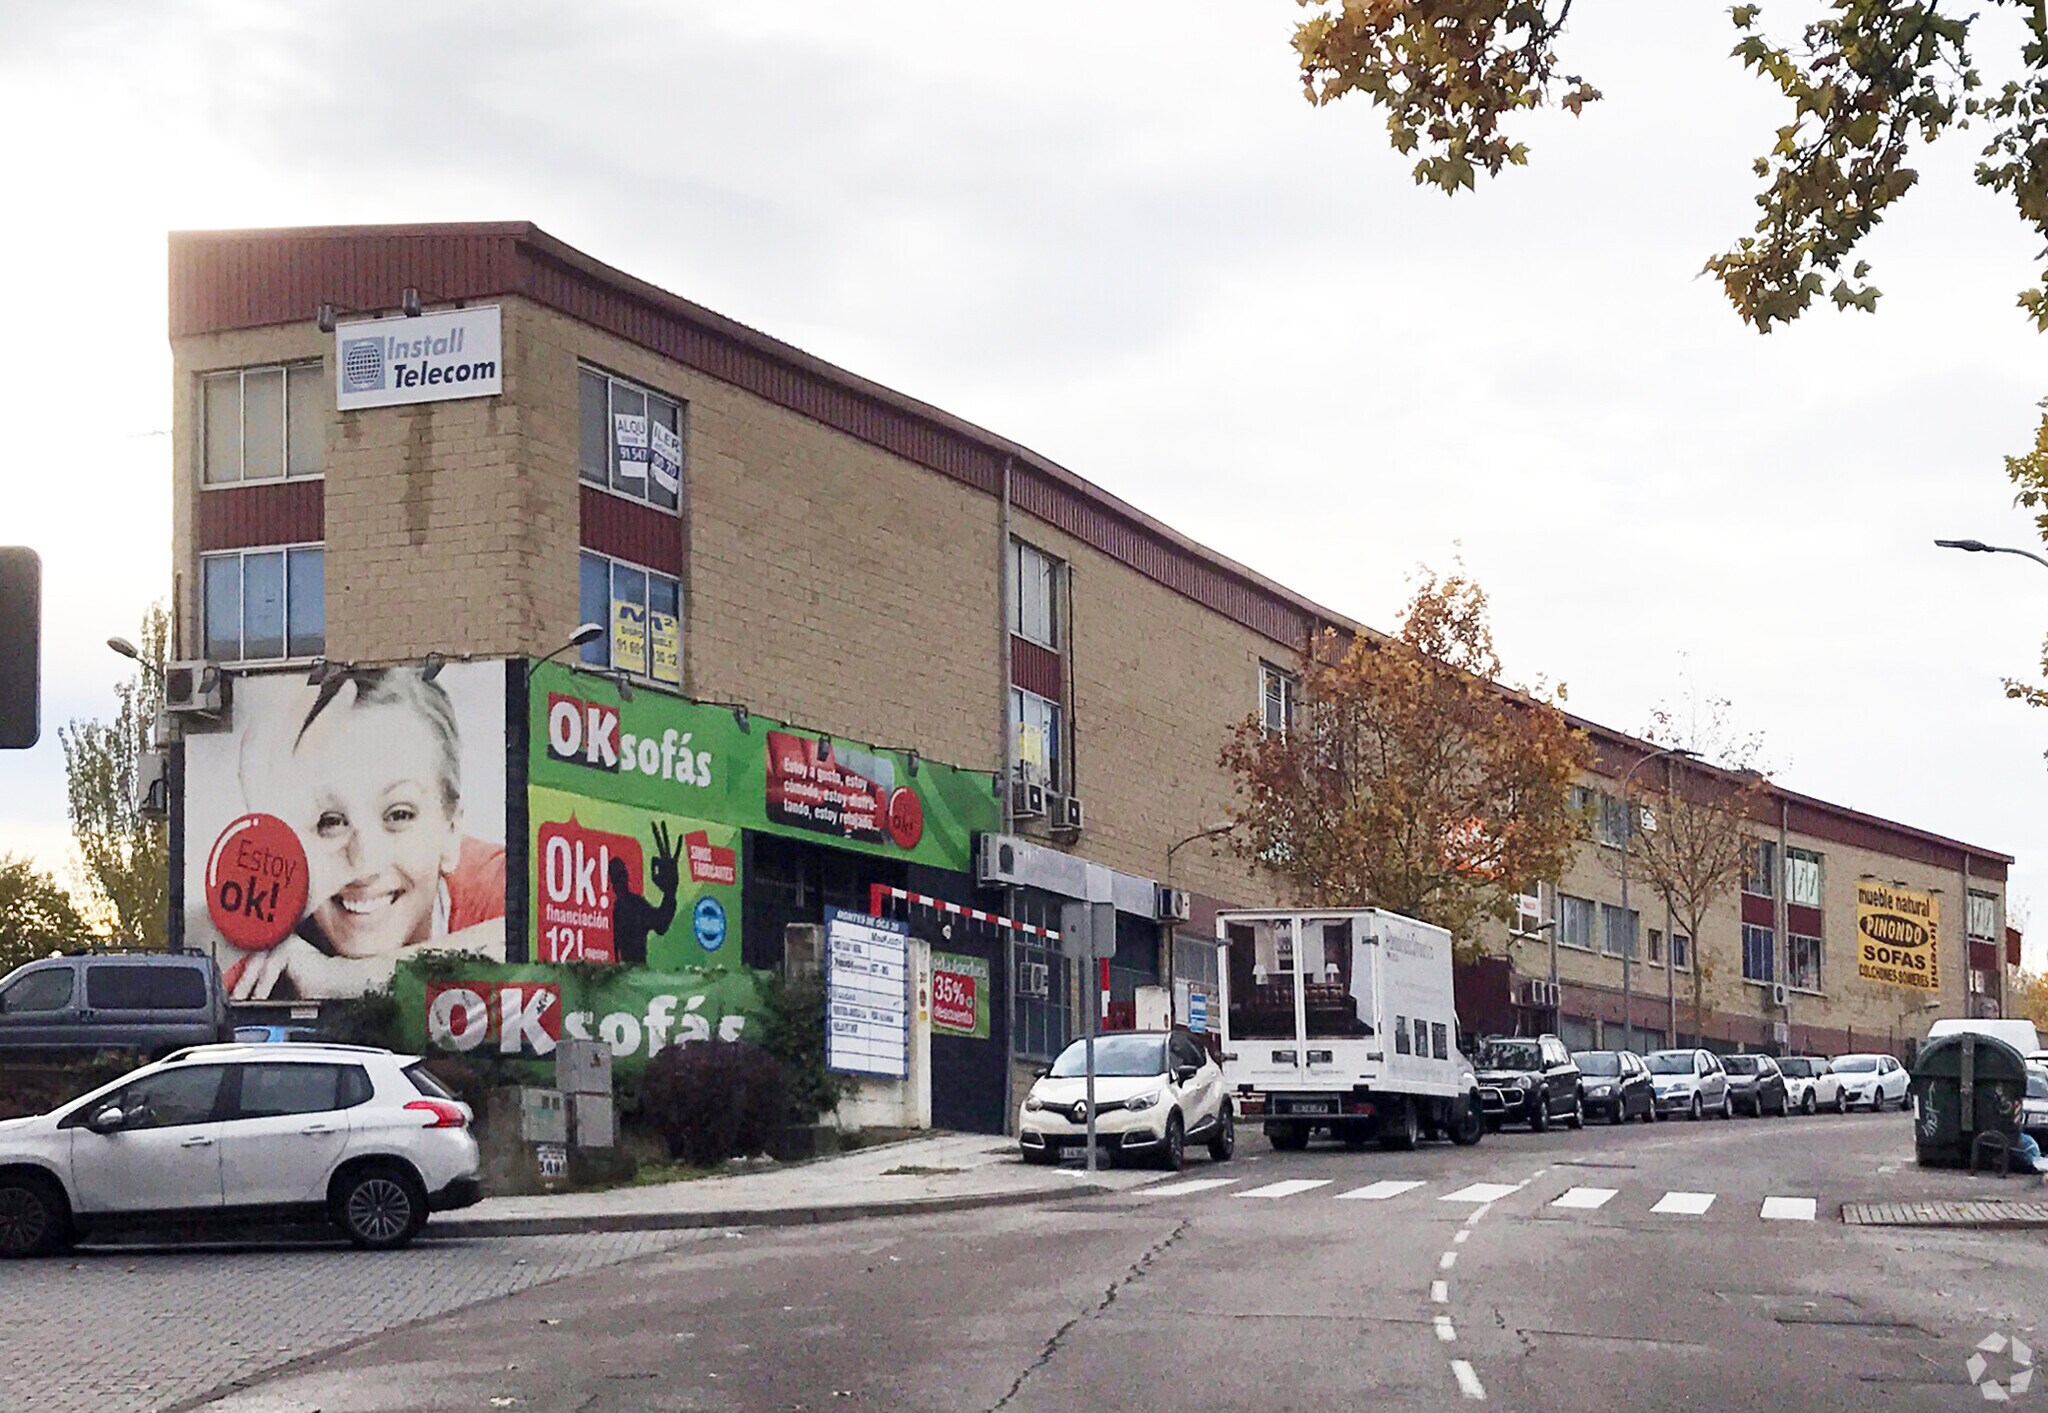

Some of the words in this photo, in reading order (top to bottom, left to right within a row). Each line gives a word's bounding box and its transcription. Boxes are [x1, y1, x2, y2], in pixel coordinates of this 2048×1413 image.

[387, 327, 464, 361] Install
[394, 360, 496, 389] Telecom
[237, 839, 297, 888] Estoy
[546, 836, 609, 909] Ok!
[545, 902, 609, 930] financiación
[1858, 887, 1894, 911] mueble
[1895, 895, 1930, 918] natural
[1866, 914, 1924, 945] PINONDO
[1863, 945, 1926, 971] SOFAS
